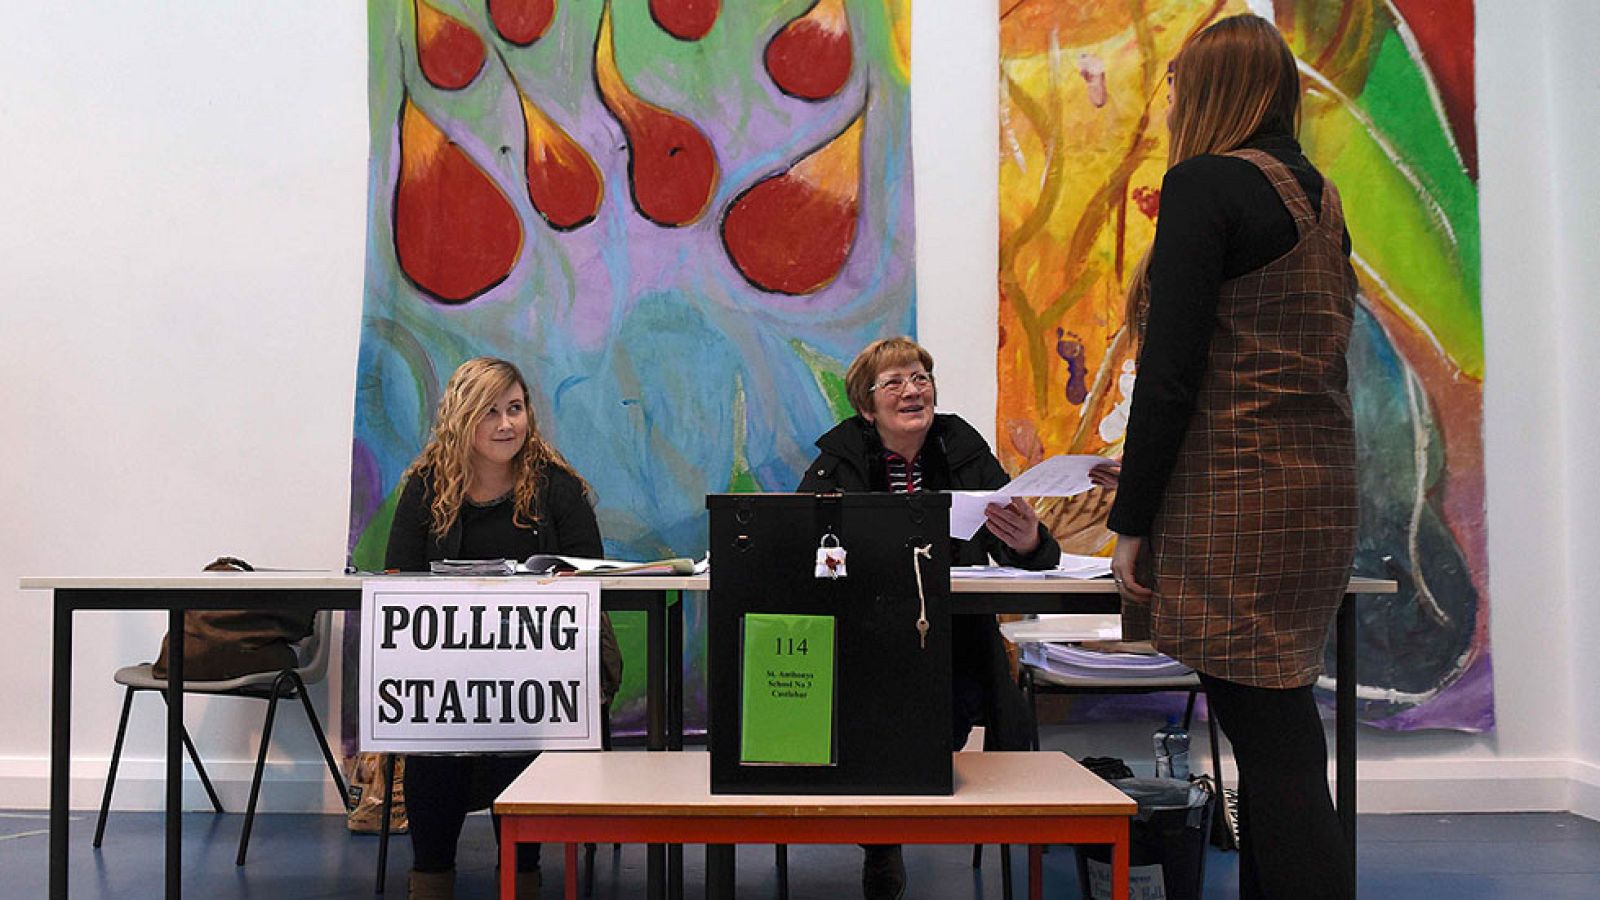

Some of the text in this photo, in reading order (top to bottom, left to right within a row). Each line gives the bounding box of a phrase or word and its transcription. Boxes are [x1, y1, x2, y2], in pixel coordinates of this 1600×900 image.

[380, 605, 579, 651] POLLING
[775, 637, 809, 655] 114
[768, 680, 793, 688] School
[378, 679, 580, 724] STATION
